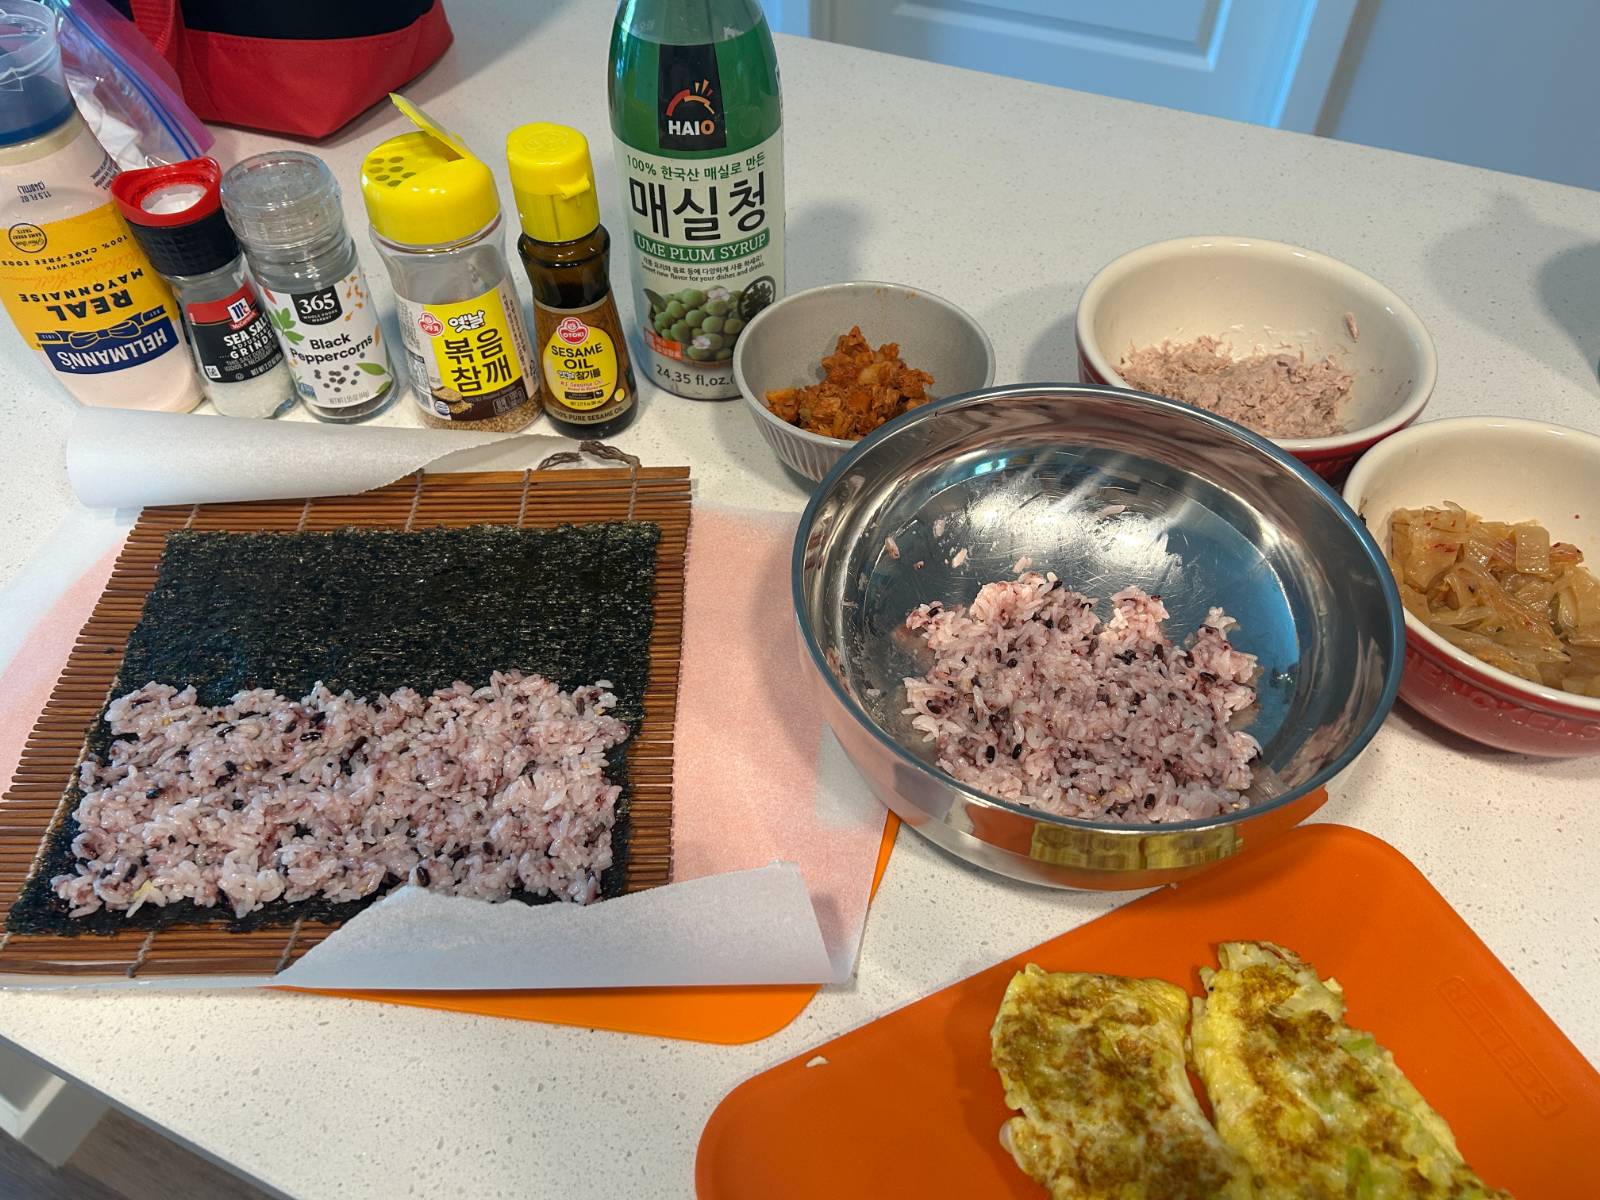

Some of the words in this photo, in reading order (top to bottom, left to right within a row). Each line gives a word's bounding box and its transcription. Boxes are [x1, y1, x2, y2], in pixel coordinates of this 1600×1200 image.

[668, 119, 716, 136] HAIO
[626, 154, 657, 175] 100%
[660, 165, 700, 182] 한국산
[704, 162, 742, 180] 매실로
[745, 151, 766, 170] 만든
[629, 171, 766, 241] 매실청
[101, 235, 128, 249] 100%
[636, 235, 666, 257] UME
[670, 248, 716, 261] PLUM
[720, 233, 766, 260] SYRUP
[35, 247, 98, 265] CAGE-FREE
[69, 257, 93, 267] MADE
[46, 263, 68, 271] WITH
[18, 267, 144, 303] MAYONNAISE
[46, 289, 134, 321] REAL
[299, 292, 335, 314] 365
[56, 328, 168, 370] HELLMANN'S
[224, 330, 250, 347] SEA
[230, 327, 275, 359] GRINDE
[309, 333, 351, 350] Black
[444, 328, 502, 365] 볶음
[289, 335, 373, 365] Peppercorns
[551, 342, 604, 358] SESAME
[451, 354, 512, 393] 참깨
[564, 359, 594, 369] OIL
[656, 364, 691, 384] 24.35
[587, 409, 613, 421] SESAME
